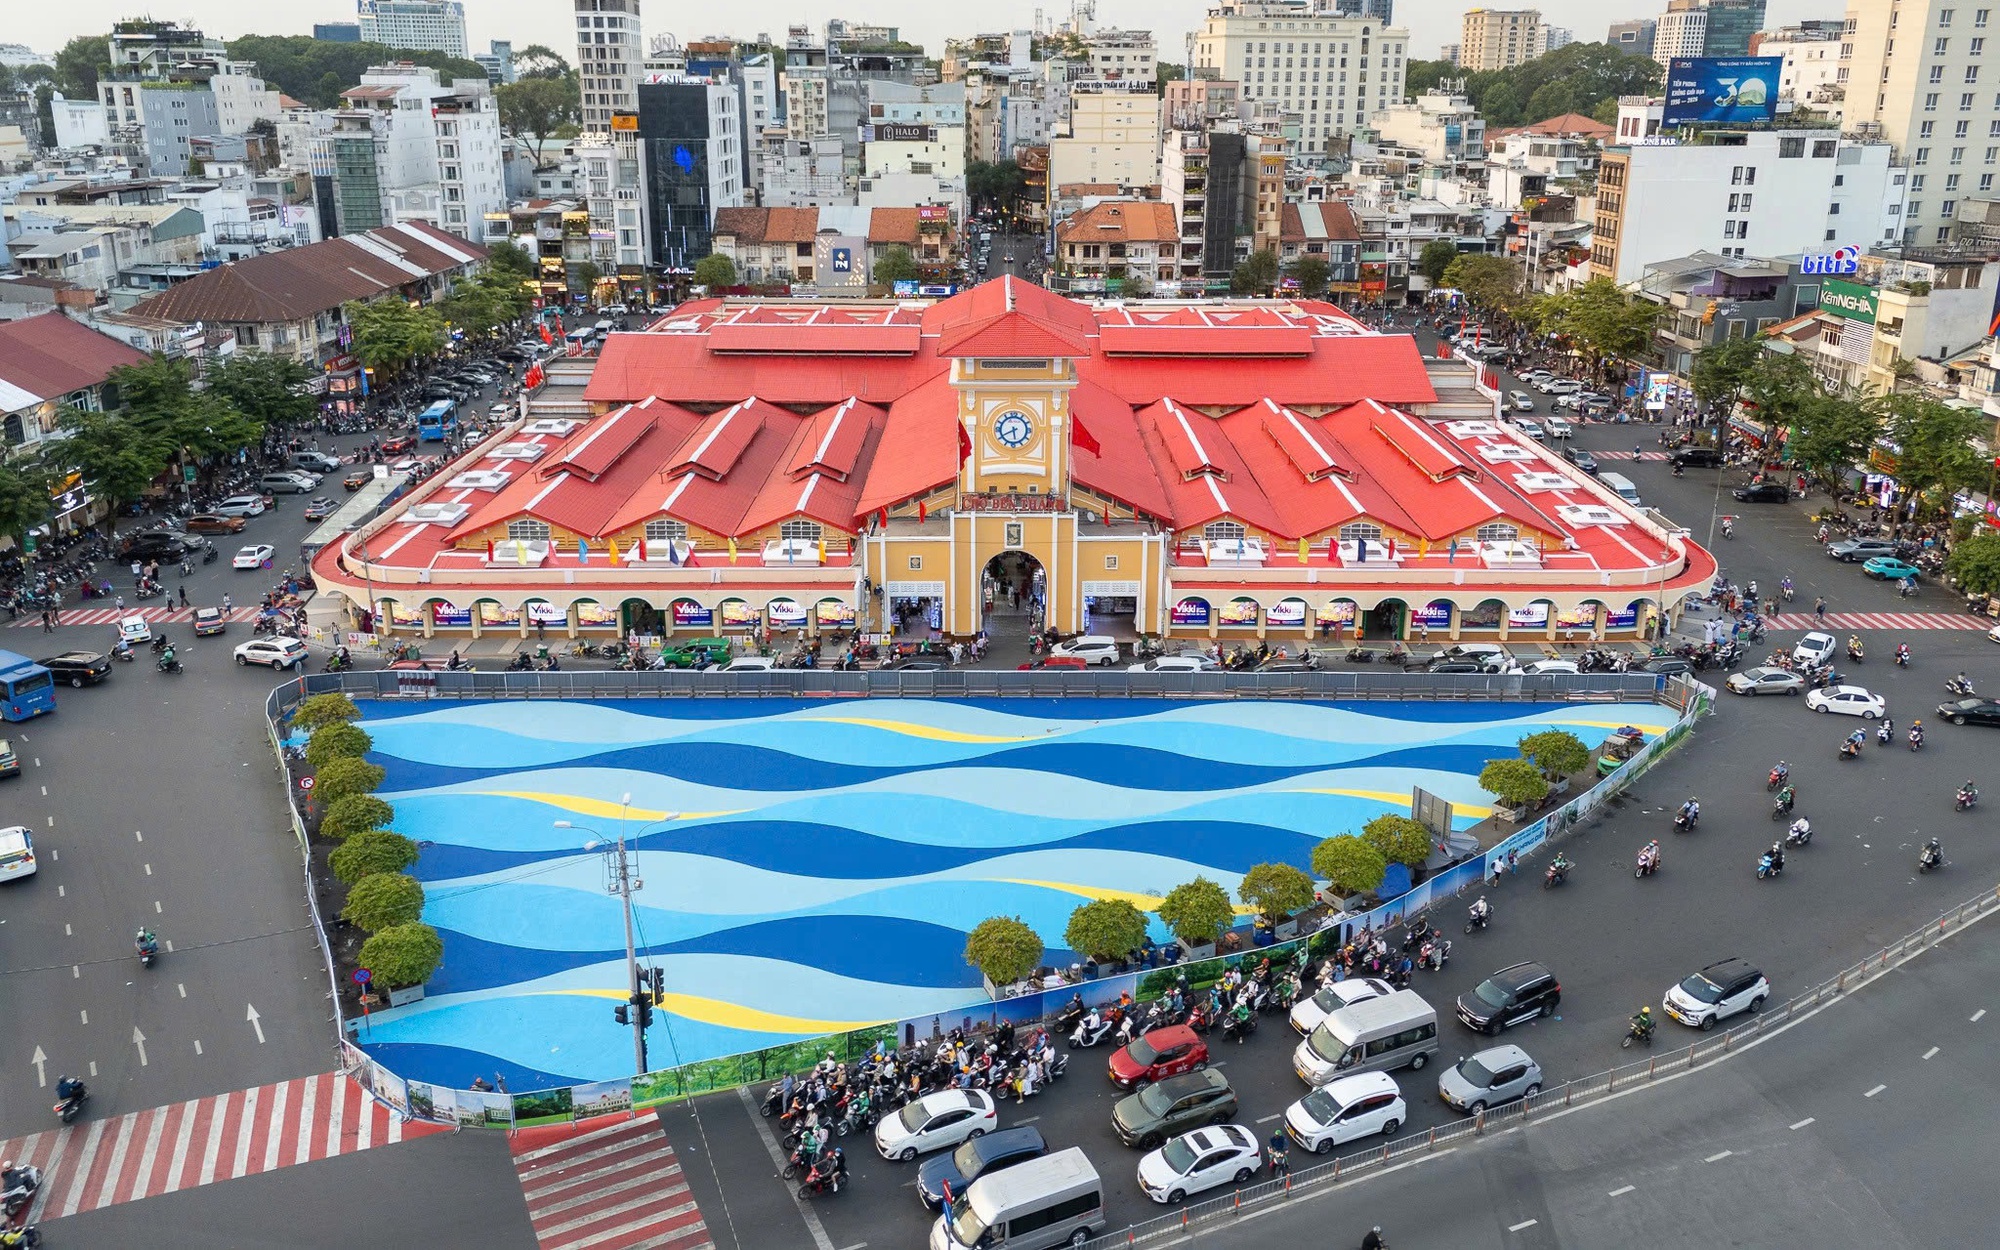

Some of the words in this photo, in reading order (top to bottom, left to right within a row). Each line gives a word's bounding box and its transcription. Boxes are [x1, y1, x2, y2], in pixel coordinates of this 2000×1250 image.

[644, 74, 682, 83] AVANTI
[1714, 77, 1767, 107] 30
[895, 128, 920, 136] HALO
[835, 260, 849, 270] PNJ
[532, 603, 553, 614] Vikki
[676, 601, 699, 614] Vikki
[772, 602, 794, 613] Vikki
[1176, 601, 1196, 613] Vikki
[1272, 603, 1292, 614] Vikki
